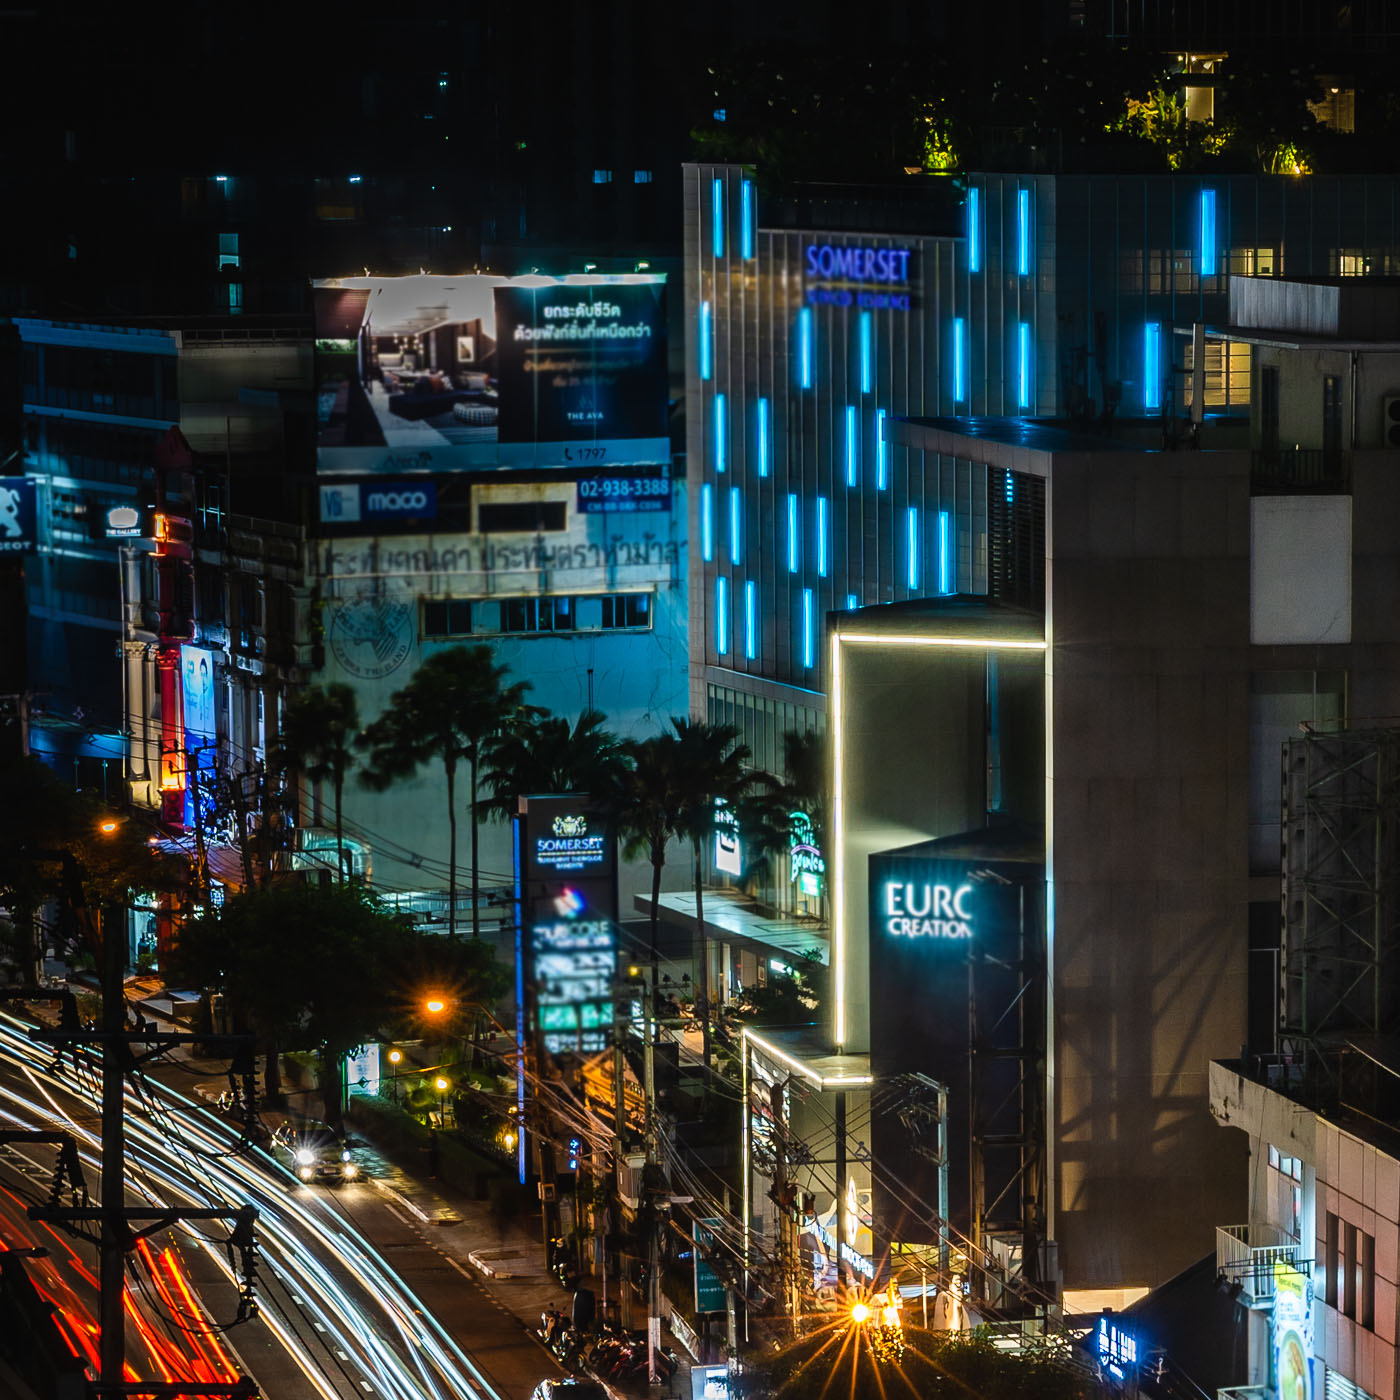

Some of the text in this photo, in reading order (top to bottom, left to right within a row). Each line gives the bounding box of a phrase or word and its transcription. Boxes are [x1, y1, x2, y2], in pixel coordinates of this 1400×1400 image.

[806, 245, 910, 280] SOMERSET
[544, 301, 621, 318] ยกระดับชีวิต
[567, 412, 604, 420] THE AVA
[577, 448, 607, 460] 1797
[580, 478, 670, 498] 02-938-3388
[368, 490, 427, 511] maco
[537, 836, 603, 852] SOMERSET
